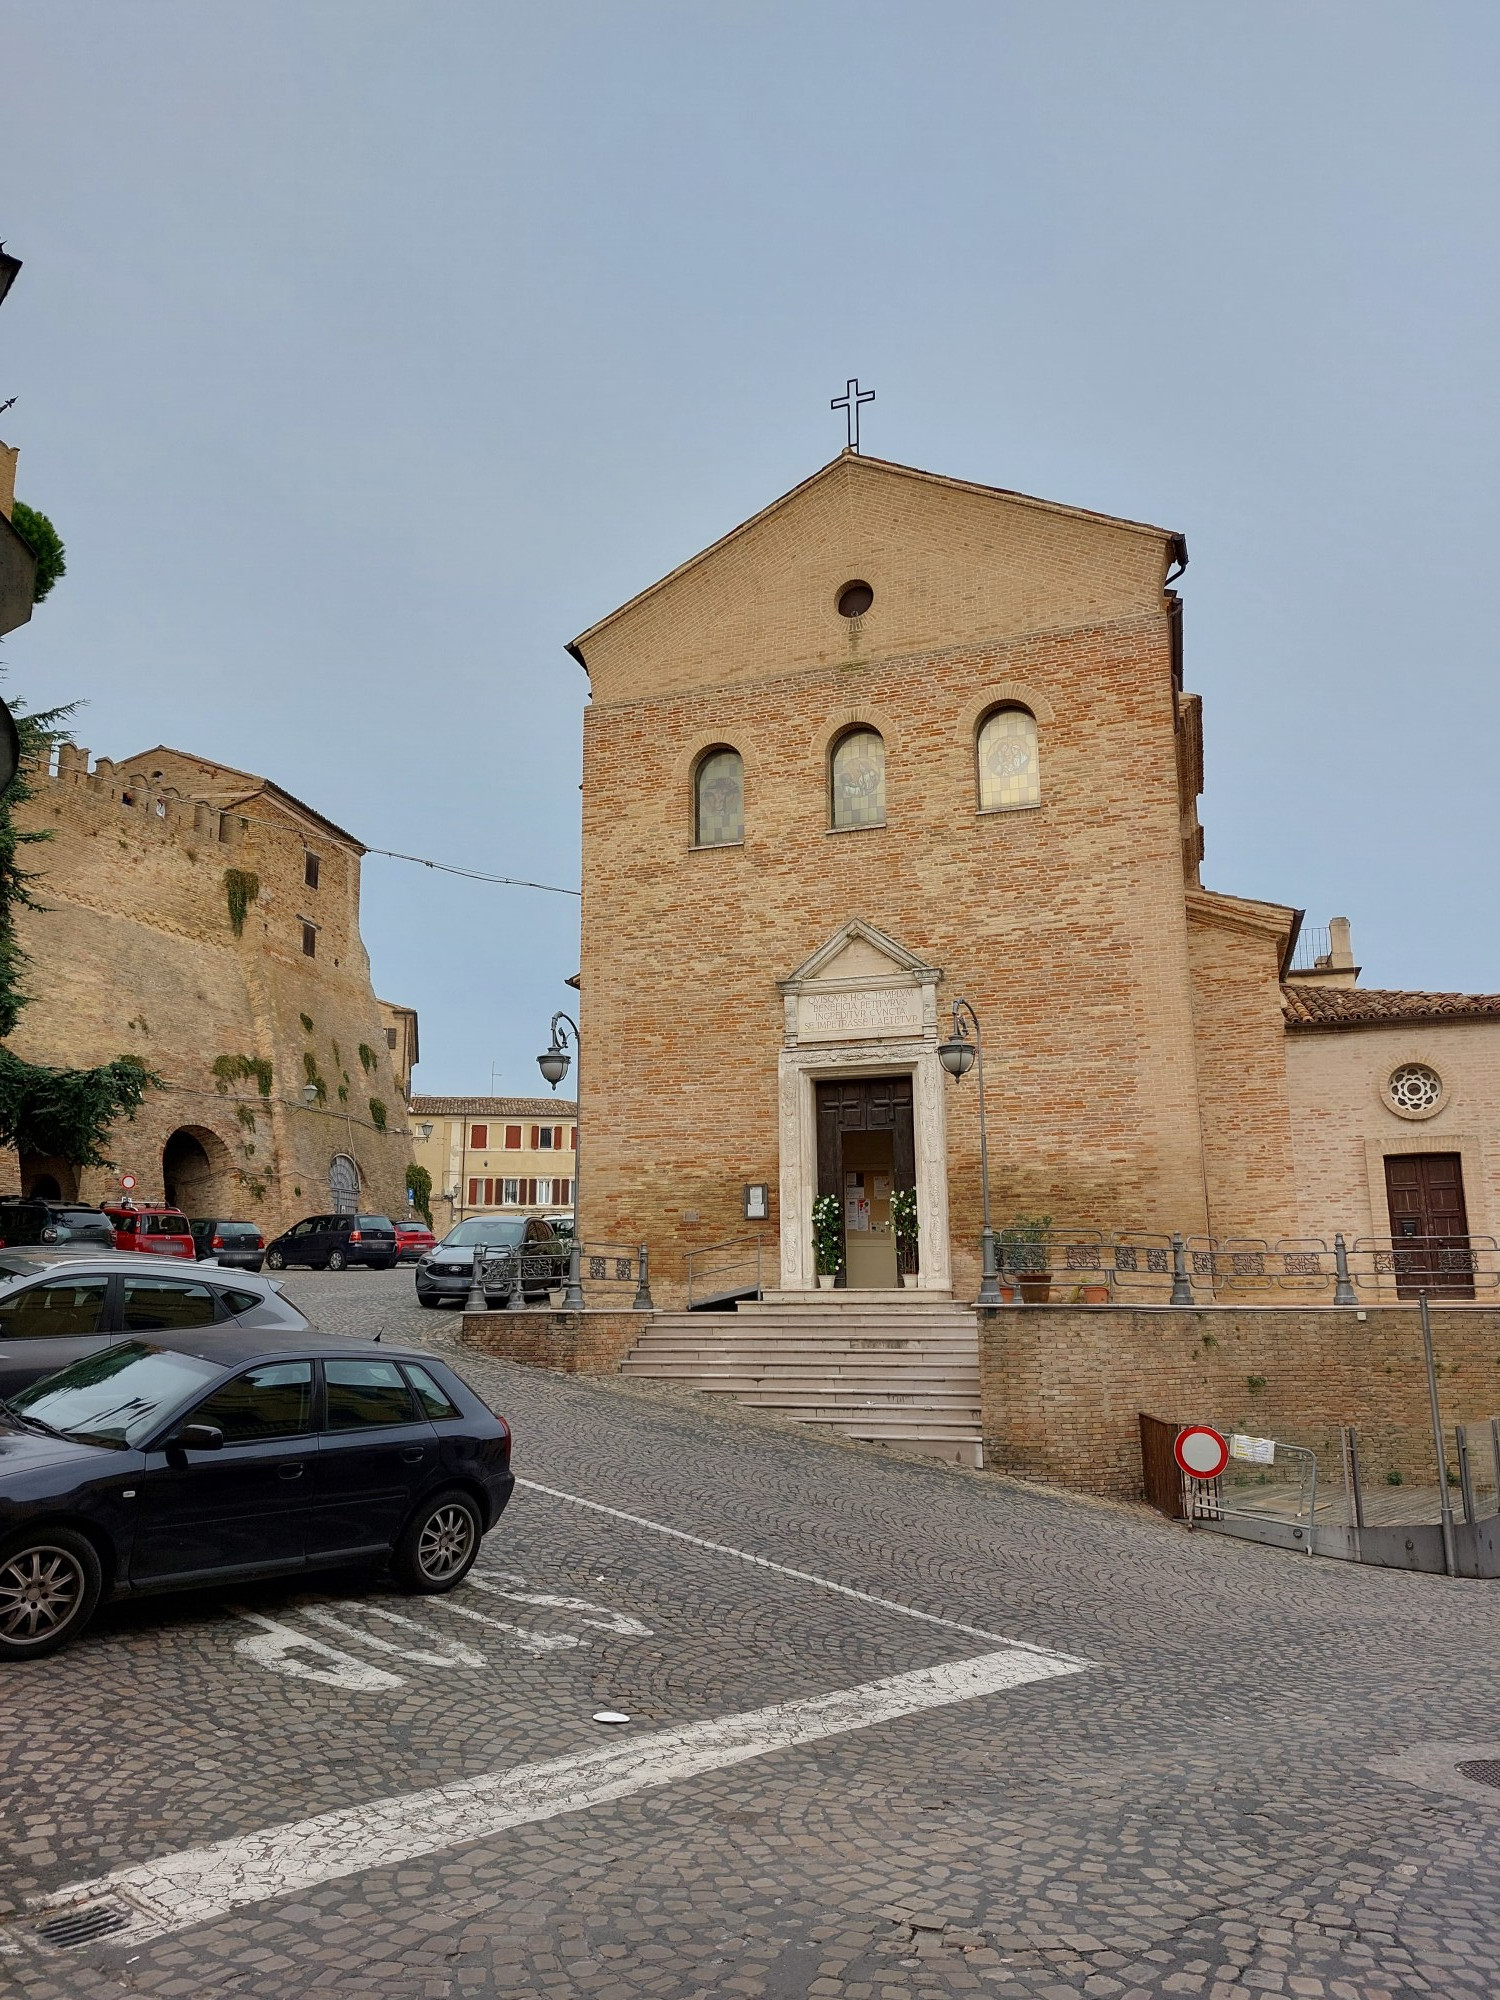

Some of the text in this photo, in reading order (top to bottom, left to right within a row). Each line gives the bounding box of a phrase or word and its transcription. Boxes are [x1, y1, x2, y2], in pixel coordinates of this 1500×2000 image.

[808, 988, 914, 1005] QVISQVIS HOC TEMPLVM
[813, 998, 908, 1013] BENEFICIA PETITVRVS
[869, 1006, 906, 1017] CVNCTA
[804, 1014, 918, 1031] SE IMPETRASSE LAETETVR
